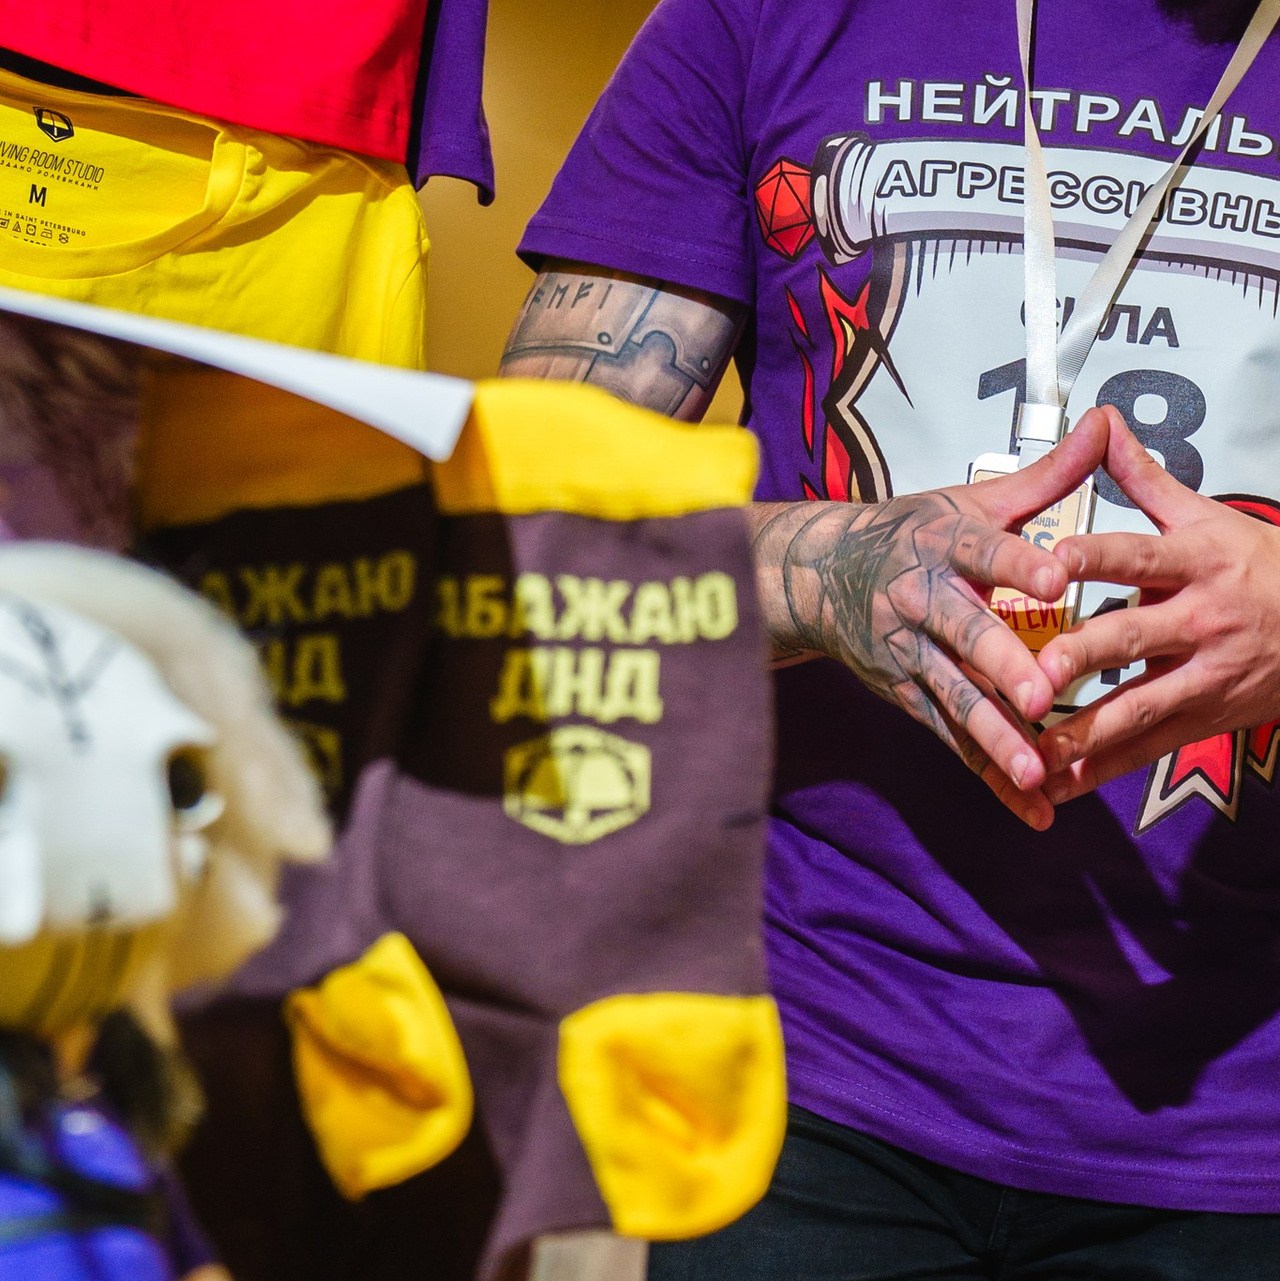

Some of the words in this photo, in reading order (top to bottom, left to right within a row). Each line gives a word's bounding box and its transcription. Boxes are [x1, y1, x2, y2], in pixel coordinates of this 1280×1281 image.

[29, 149, 65, 172] ROOM
[64, 158, 105, 183] STUDIO
[29, 183, 47, 208] M
[15, 213, 38, 223] SAINT
[1020, 296, 1180, 348] ЛА
[1029, 516, 1060, 528] АНДЫ
[489, 647, 665, 726] ДНД
